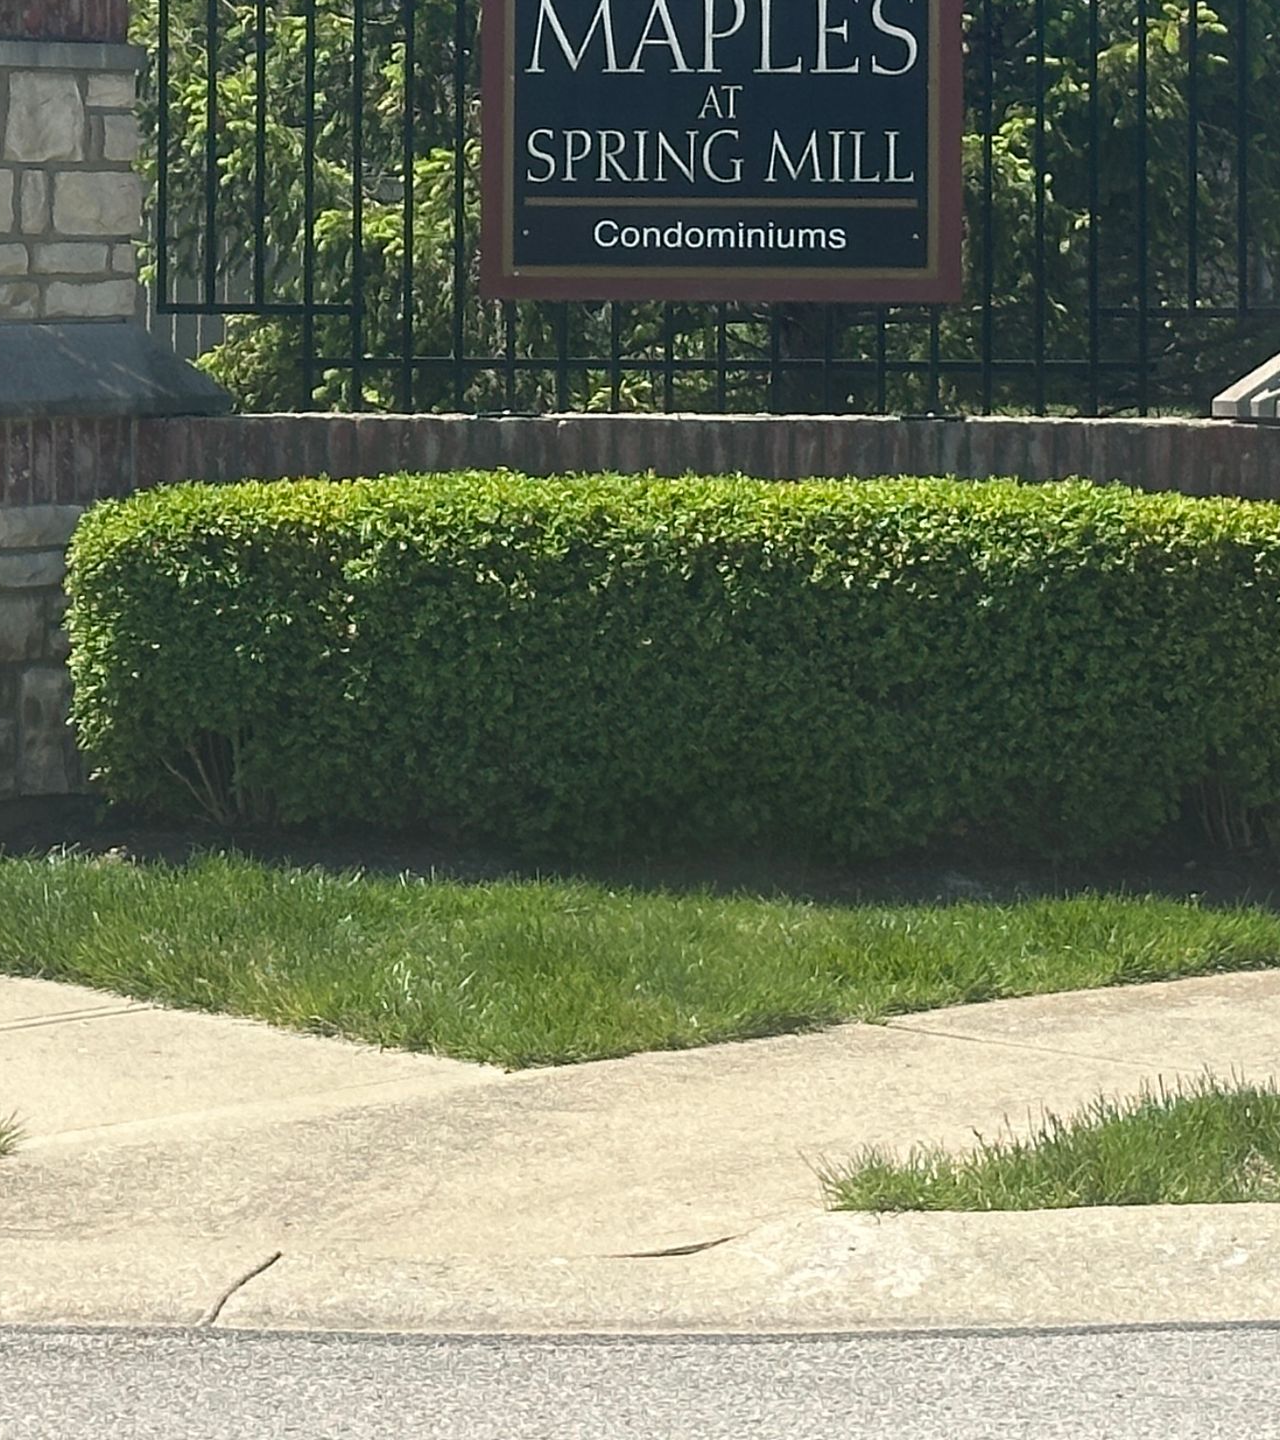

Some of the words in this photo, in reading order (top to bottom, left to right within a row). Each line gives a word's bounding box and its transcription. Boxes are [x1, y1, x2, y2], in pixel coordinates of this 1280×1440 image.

[698, 86, 742, 118] AT
[528, 129, 744, 182] SPRING
[765, 130, 914, 182] MILL
[595, 221, 846, 248] Condominiums
